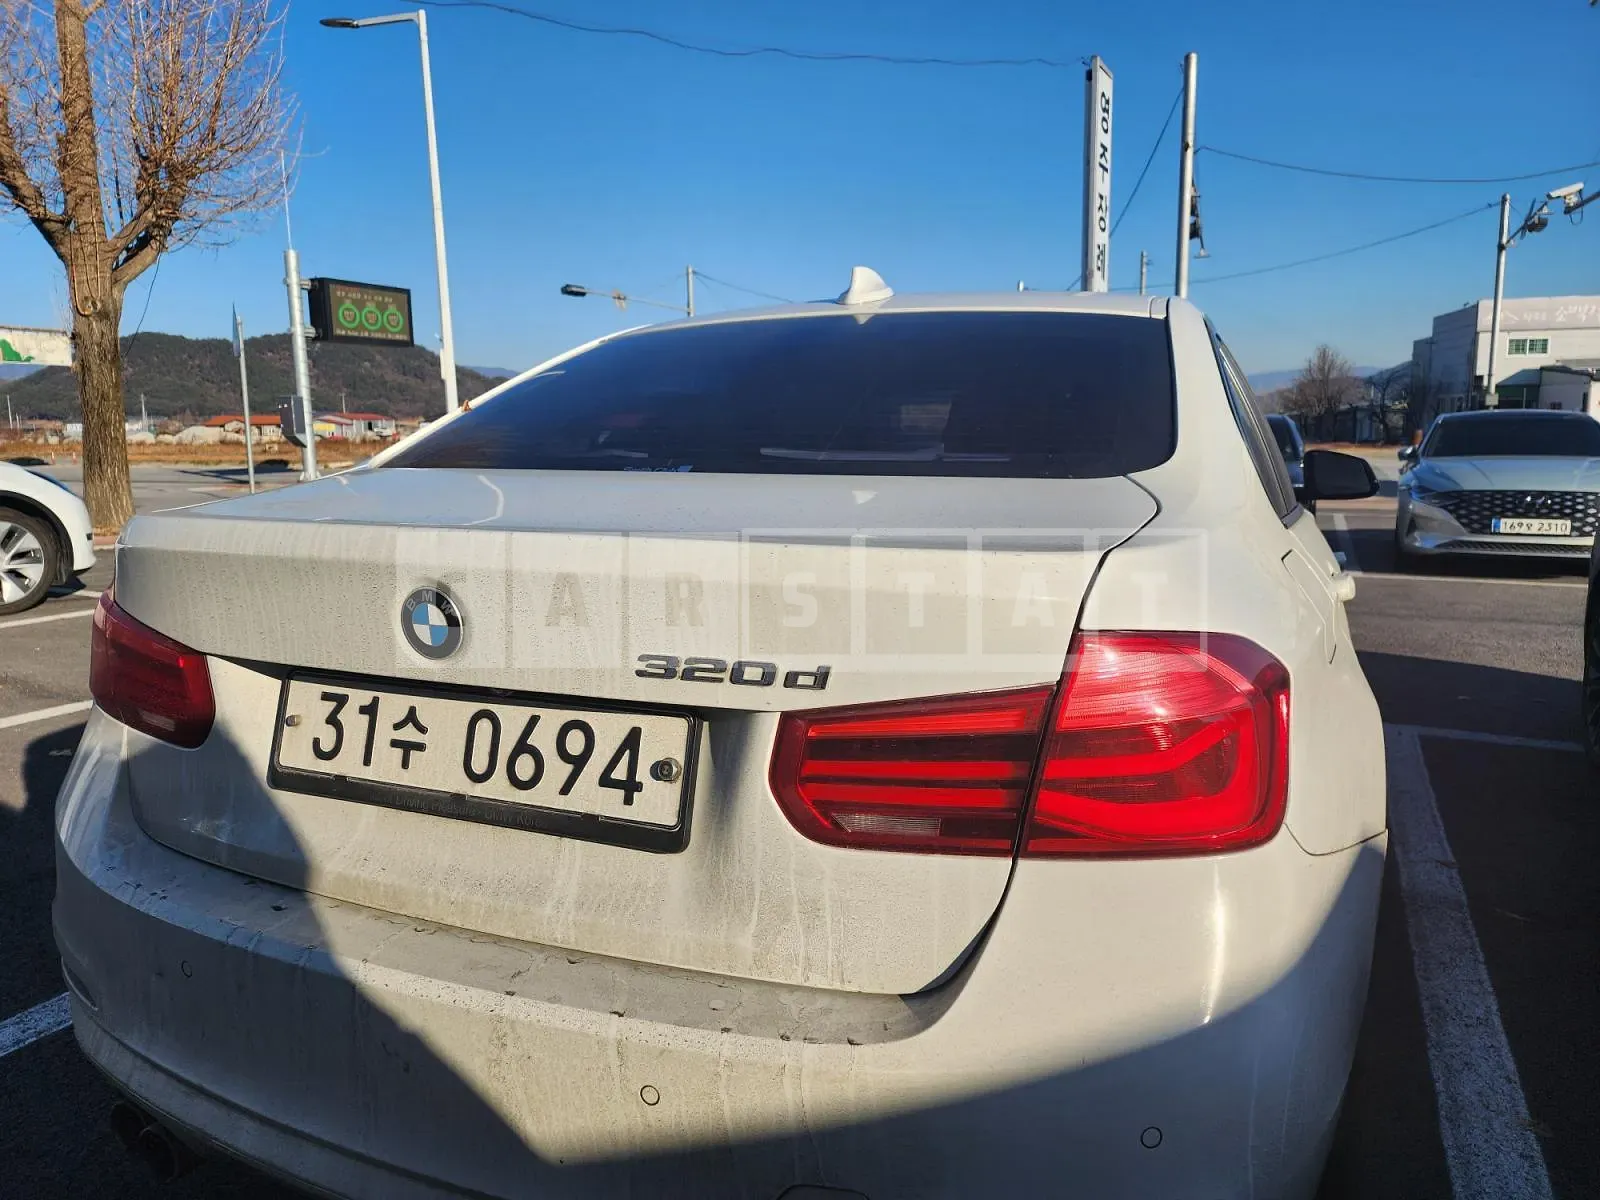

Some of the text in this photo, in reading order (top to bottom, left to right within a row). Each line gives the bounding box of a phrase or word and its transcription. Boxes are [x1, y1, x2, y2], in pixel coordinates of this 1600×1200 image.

[405, 590, 455, 615] BMW
[635, 653, 831, 690] 320d
[312, 691, 644, 806] 31수 0694
